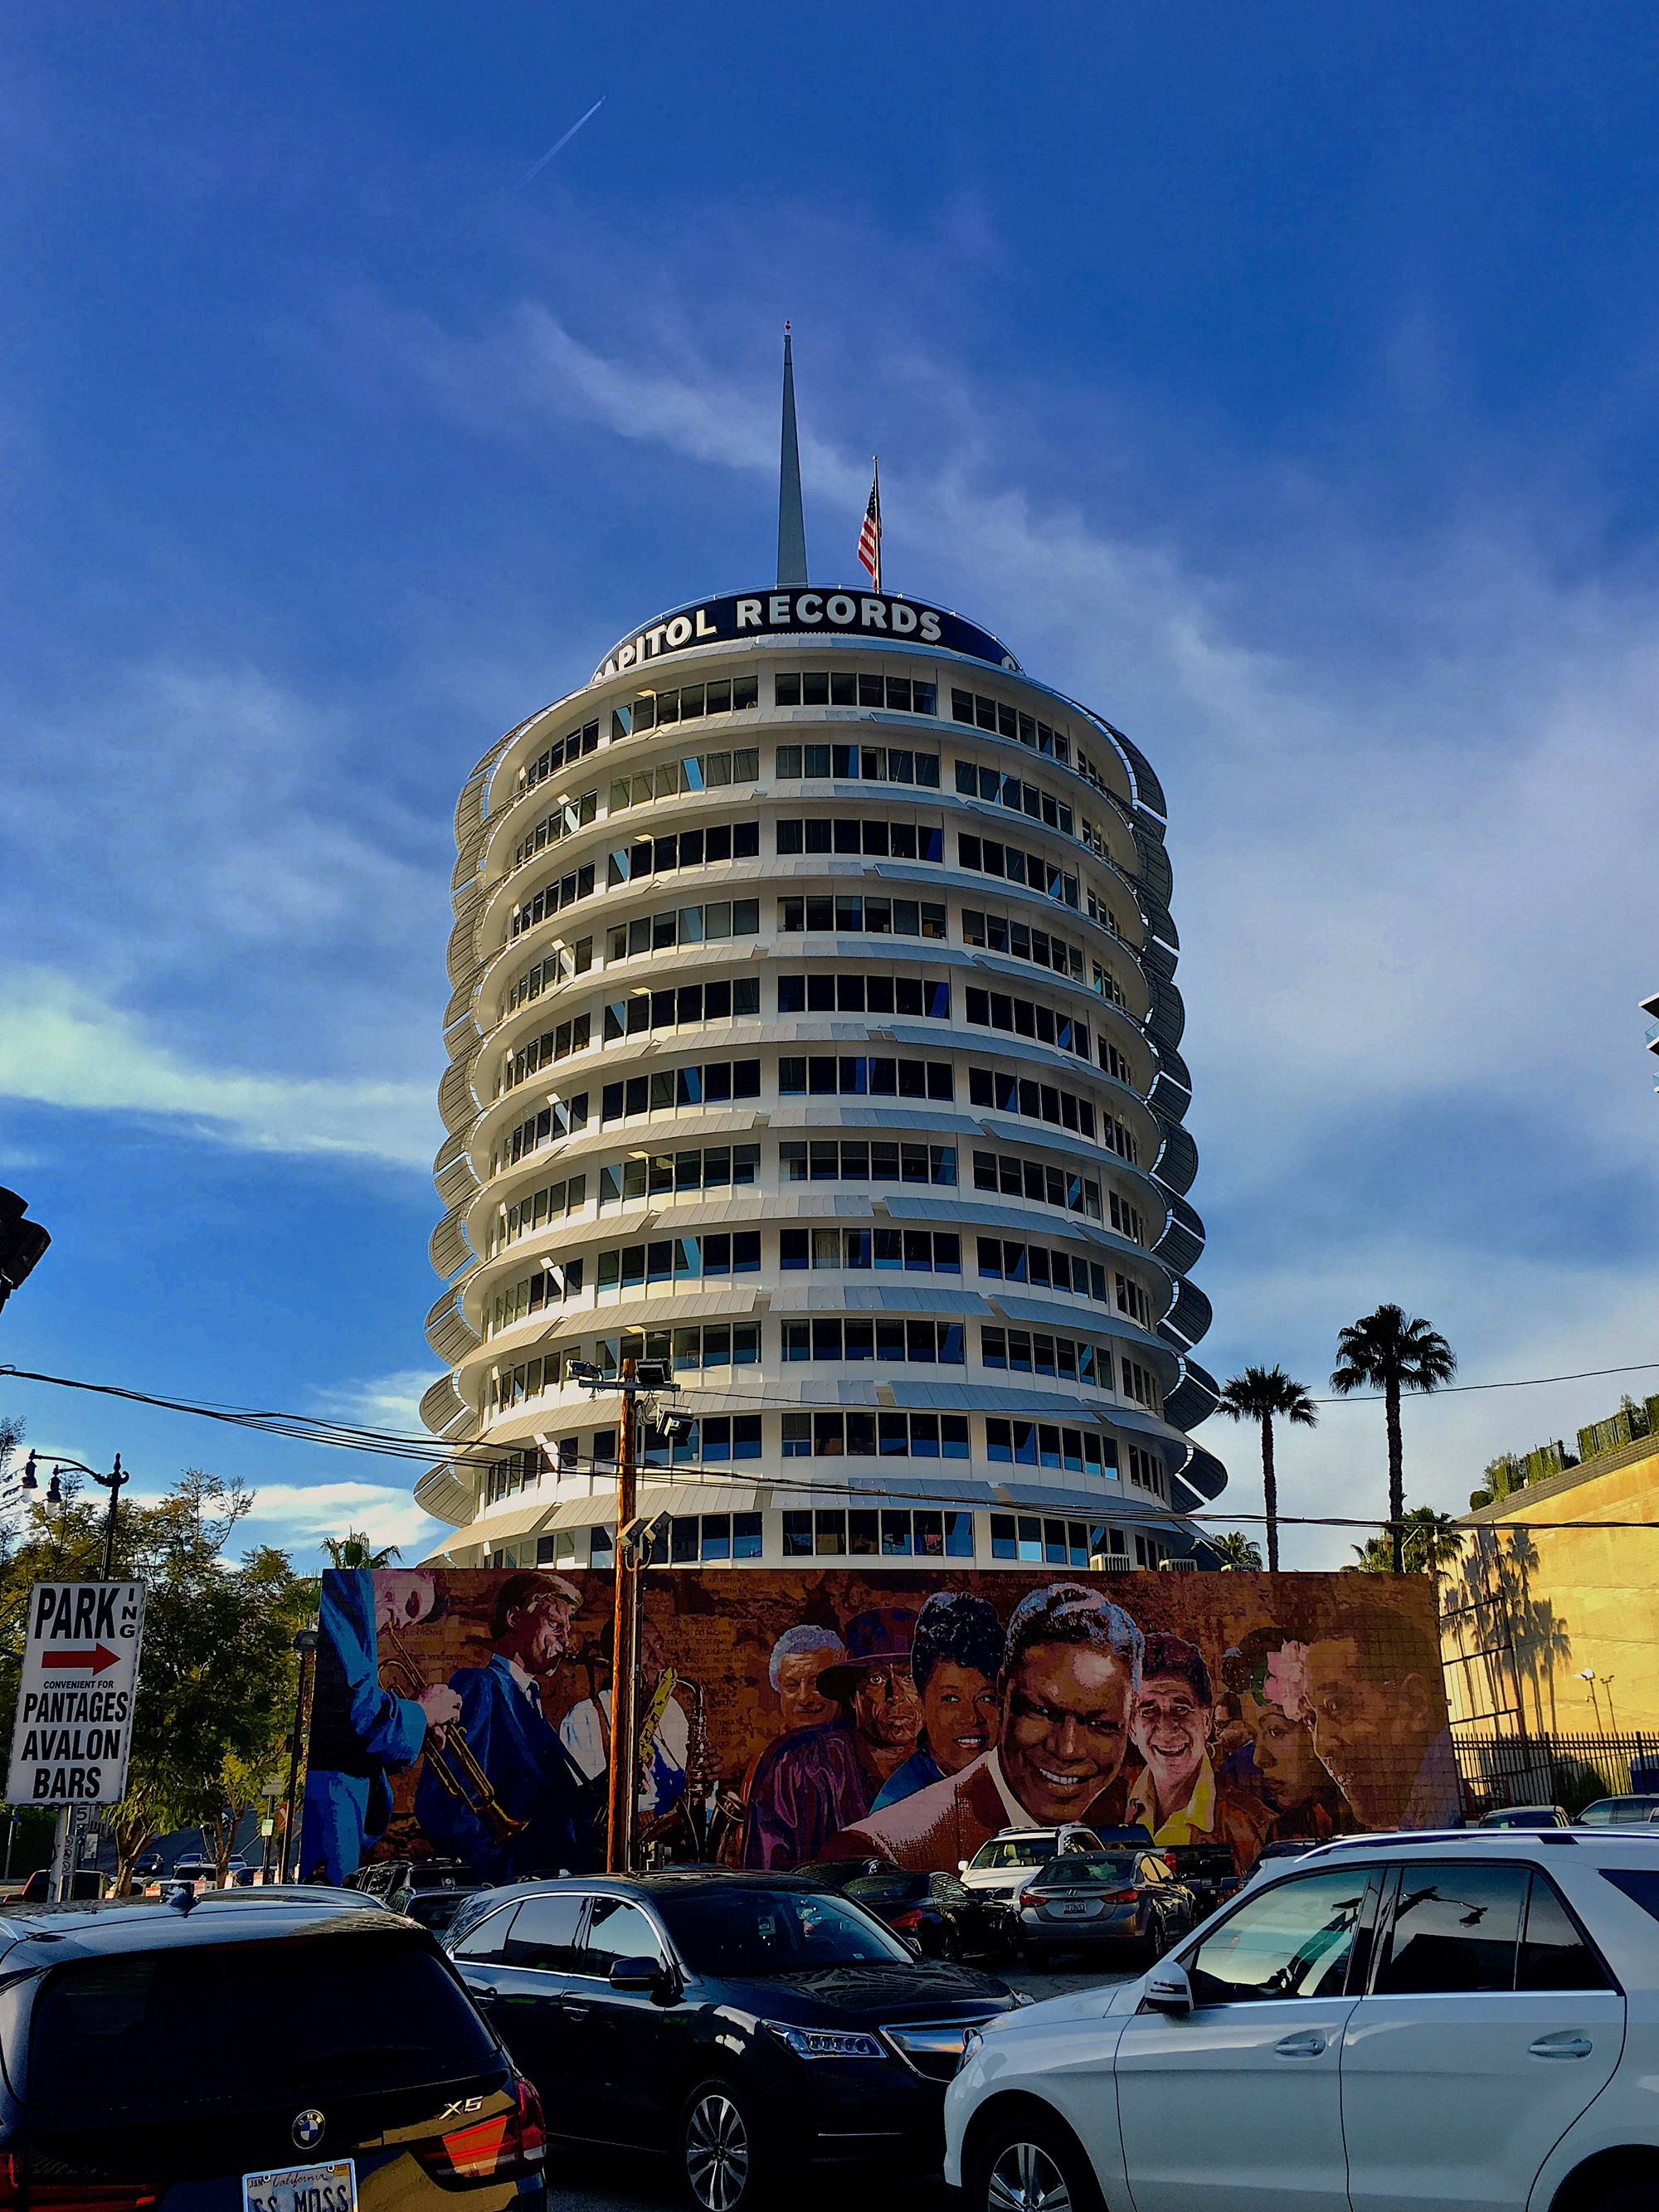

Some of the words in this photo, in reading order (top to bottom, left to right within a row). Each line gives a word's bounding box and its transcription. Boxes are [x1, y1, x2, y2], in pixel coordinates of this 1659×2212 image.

[736, 594, 942, 641] RECORDS
[34, 1587, 120, 1639] PARK
[43, 1680, 96, 1689] CONVENIENT
[97, 1680, 114, 1689] FOR
[22, 1691, 128, 1723] PANTAGES
[21, 1728, 121, 1761] AVALON
[32, 1767, 101, 1799] BARS
[439, 2096, 484, 2120] X5
[250, 2179, 264, 2188] JAN
[273, 2172, 328, 2188] California
[294, 2185, 348, 2212] MOSS
